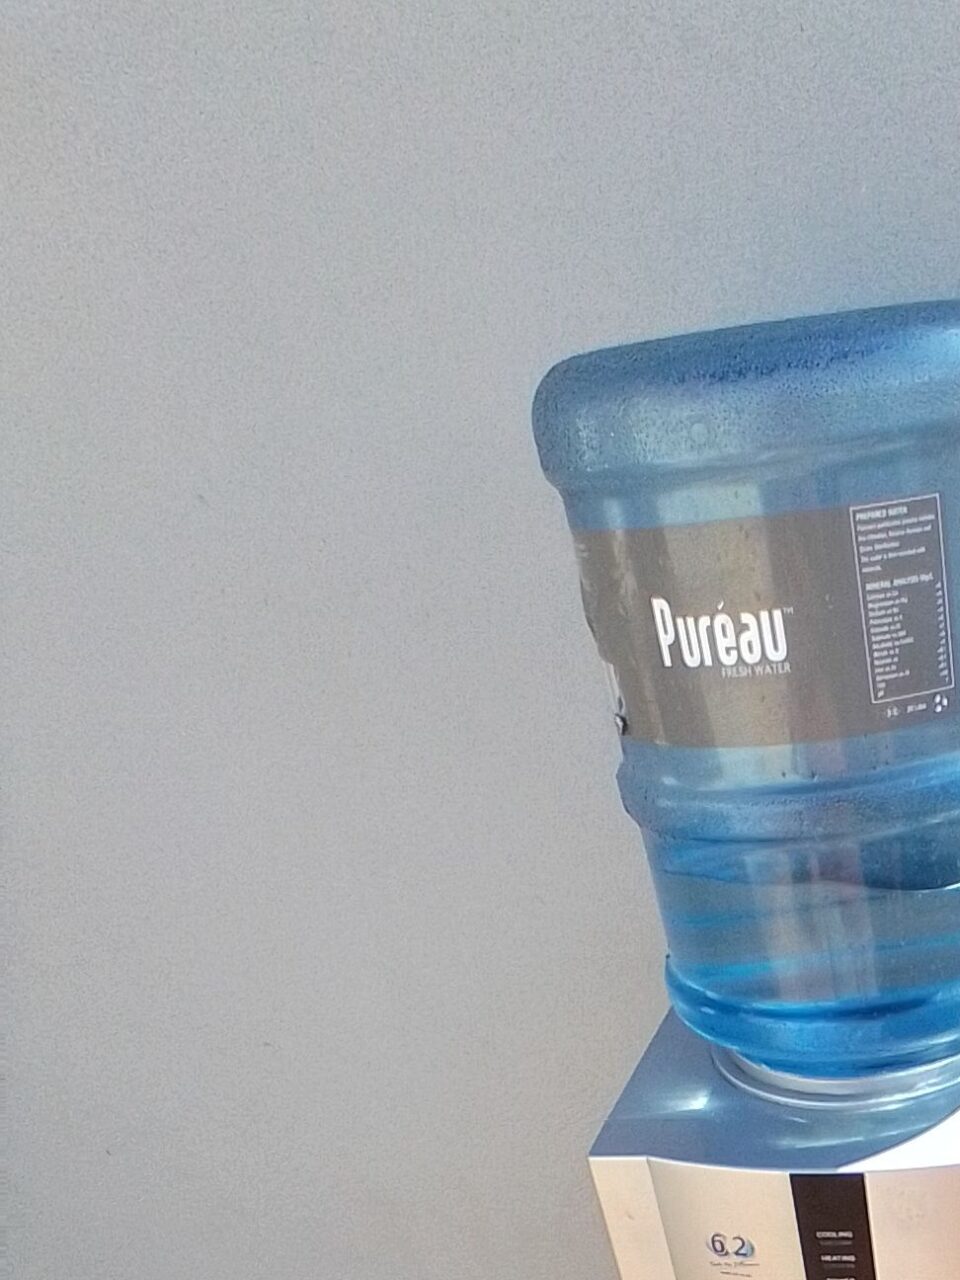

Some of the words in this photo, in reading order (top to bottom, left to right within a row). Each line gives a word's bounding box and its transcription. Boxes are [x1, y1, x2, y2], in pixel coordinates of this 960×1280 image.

[650, 596, 788, 668] Puréau
[721, 666, 752, 679] FRESH
[754, 662, 791, 676] WATER
[815, 1230, 854, 1239] COOLING
[820, 1254, 857, 1262] HEATING
